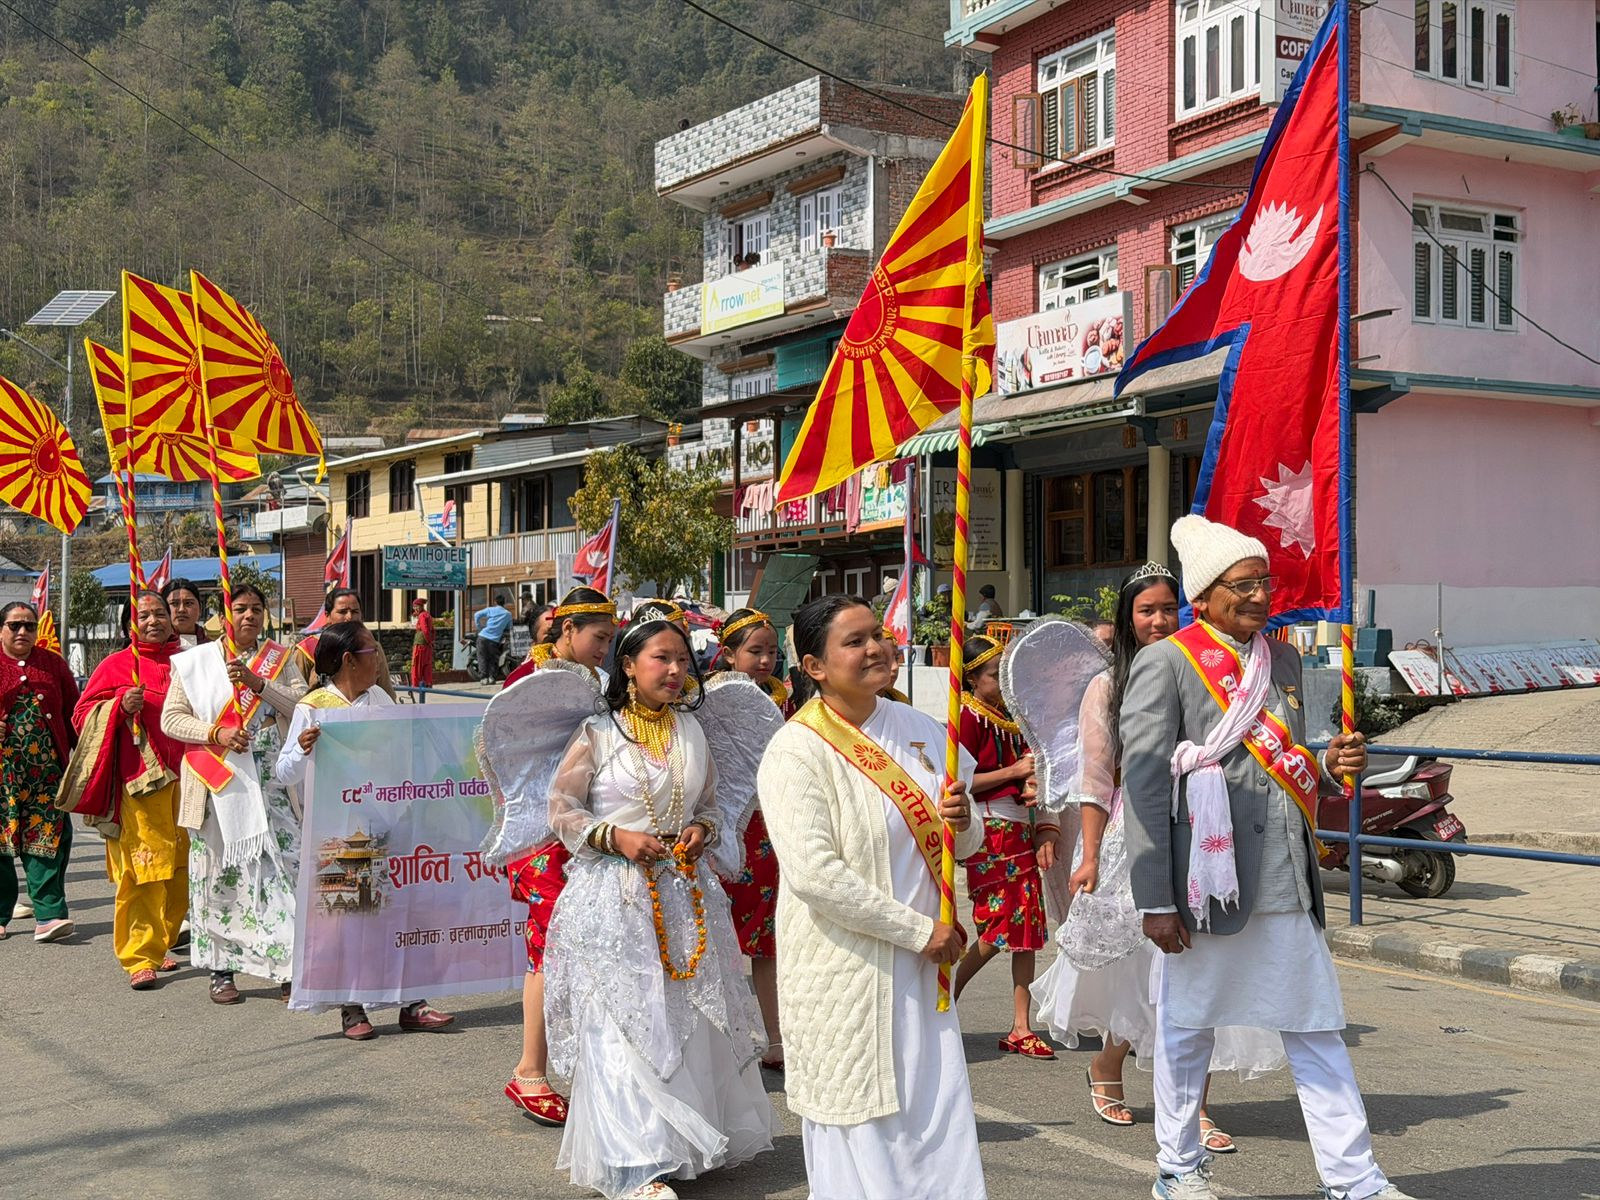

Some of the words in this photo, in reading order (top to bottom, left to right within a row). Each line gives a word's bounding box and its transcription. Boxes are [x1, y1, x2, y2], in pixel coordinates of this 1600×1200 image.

[710, 285, 762, 313] Arrownet
[385, 547, 422, 561] LAXMI
[426, 548, 466, 562] HOTEL
[888, 778, 933, 827] ओम
